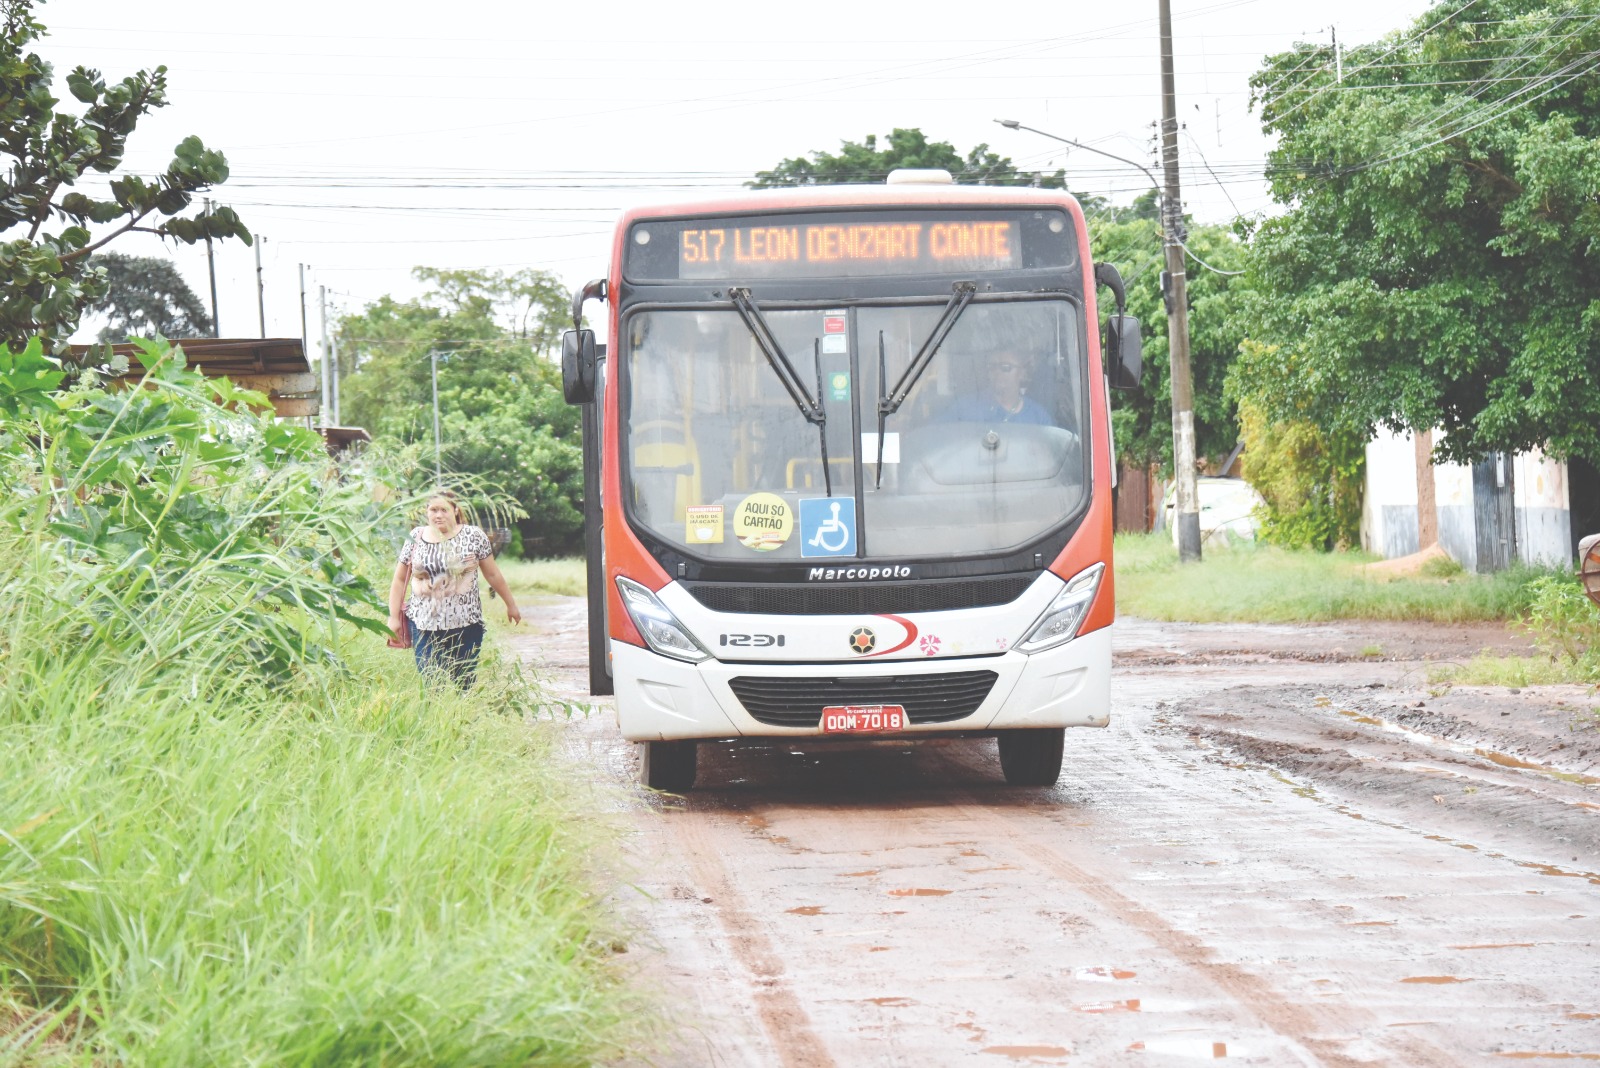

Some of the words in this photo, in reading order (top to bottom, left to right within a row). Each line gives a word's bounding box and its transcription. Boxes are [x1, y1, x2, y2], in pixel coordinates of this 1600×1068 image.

[683, 229, 725, 262] 517
[734, 227, 799, 261] LEON
[807, 224, 921, 261] DENIZART
[930, 221, 1011, 258] CONTE
[745, 502, 769, 515] AQUI
[771, 503, 785, 517] SÓ
[743, 515, 783, 530] CARTÃO
[809, 565, 911, 581] Marcopolo
[719, 633, 785, 647] 1231
